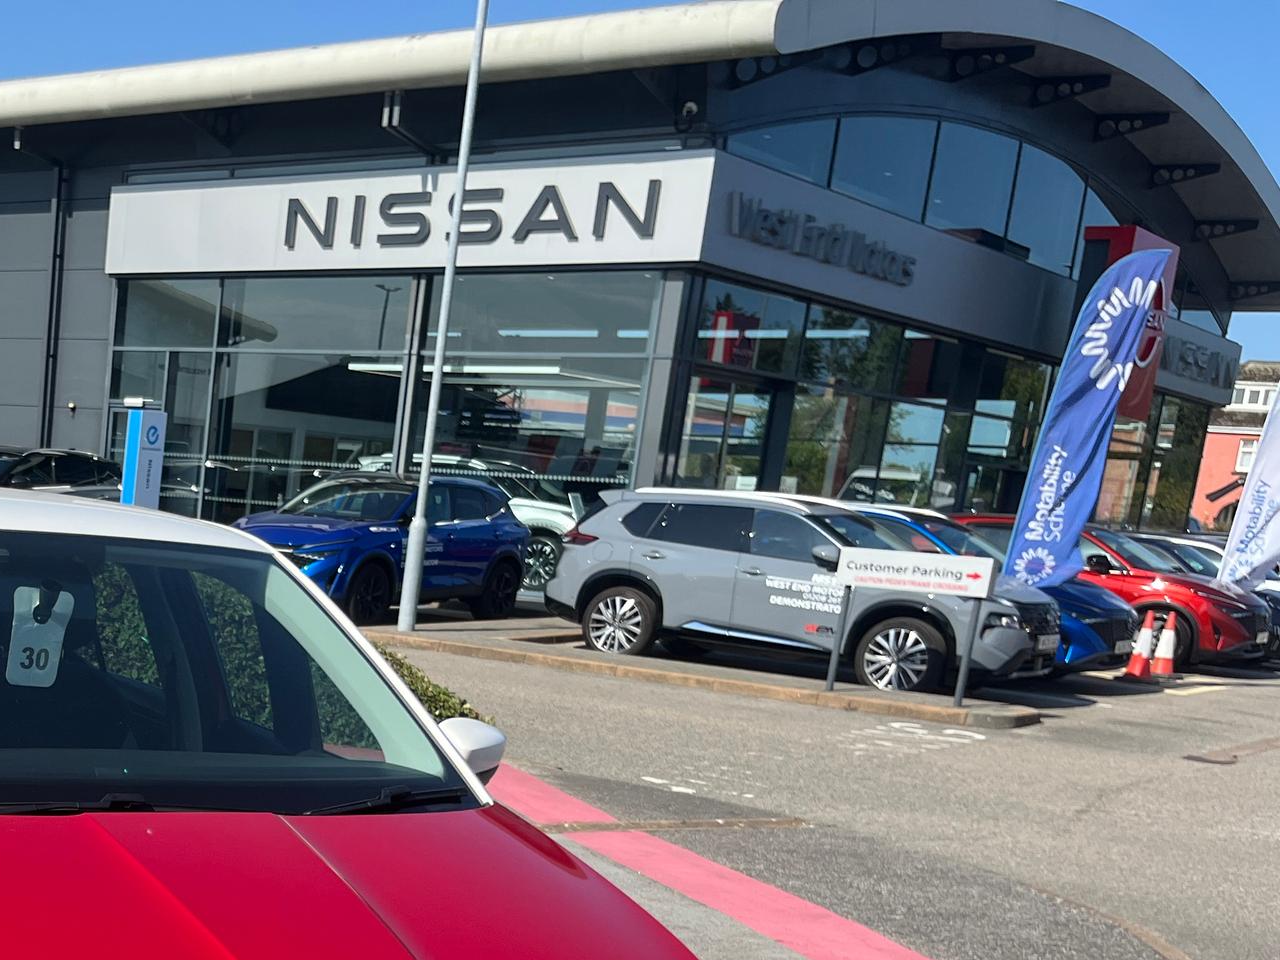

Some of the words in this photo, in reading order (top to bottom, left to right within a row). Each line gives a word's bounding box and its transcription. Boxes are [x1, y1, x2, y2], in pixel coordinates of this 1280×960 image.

[284, 179, 662, 250] NISSAN
[1024, 444, 1069, 542] Motability
[1236, 479, 1272, 554] Motability
[846, 560, 909, 575] Customer
[912, 566, 964, 581] Parking
[812, 586, 845, 598] MOTOR
[769, 595, 842, 615] DEMONSTRATO
[20, 647, 50, 671] 30
